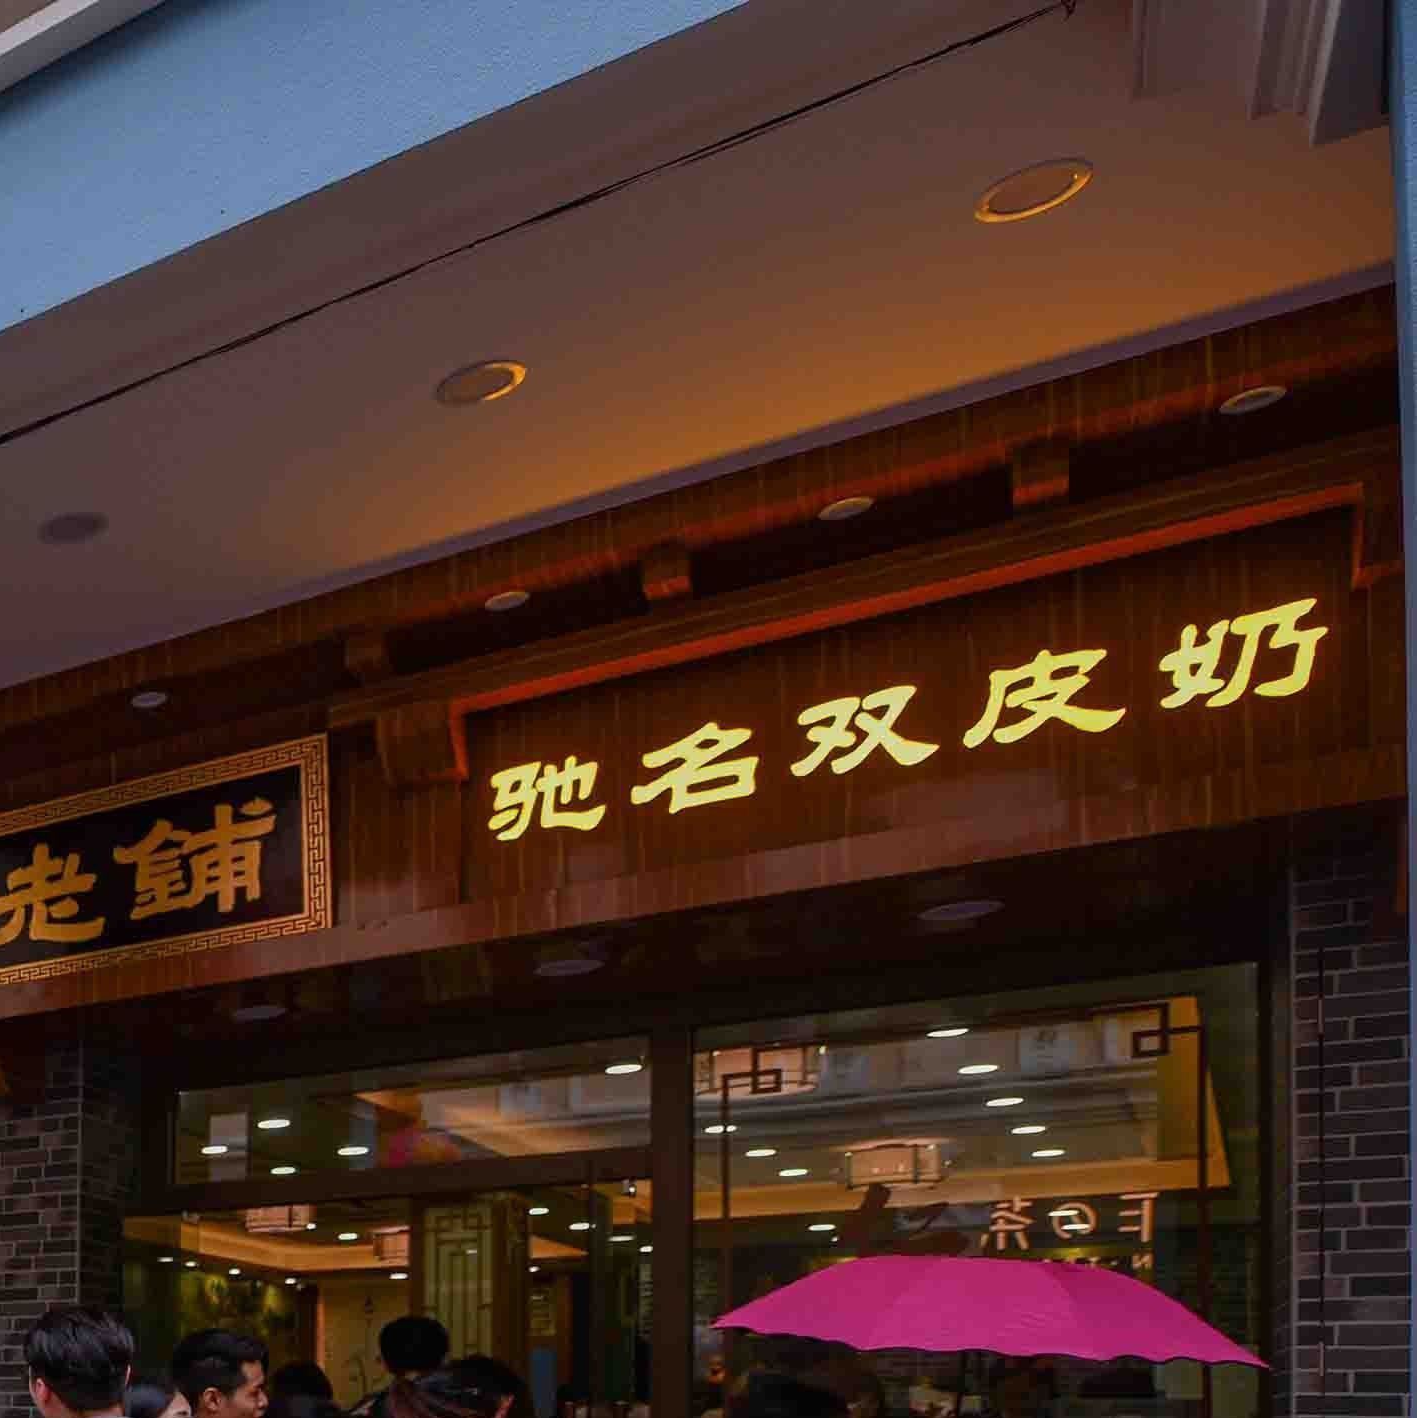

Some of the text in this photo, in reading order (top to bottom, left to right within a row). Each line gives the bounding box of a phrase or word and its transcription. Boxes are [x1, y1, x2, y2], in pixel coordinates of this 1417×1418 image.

[486, 597, 1330, 842] 驰名双皮奶
